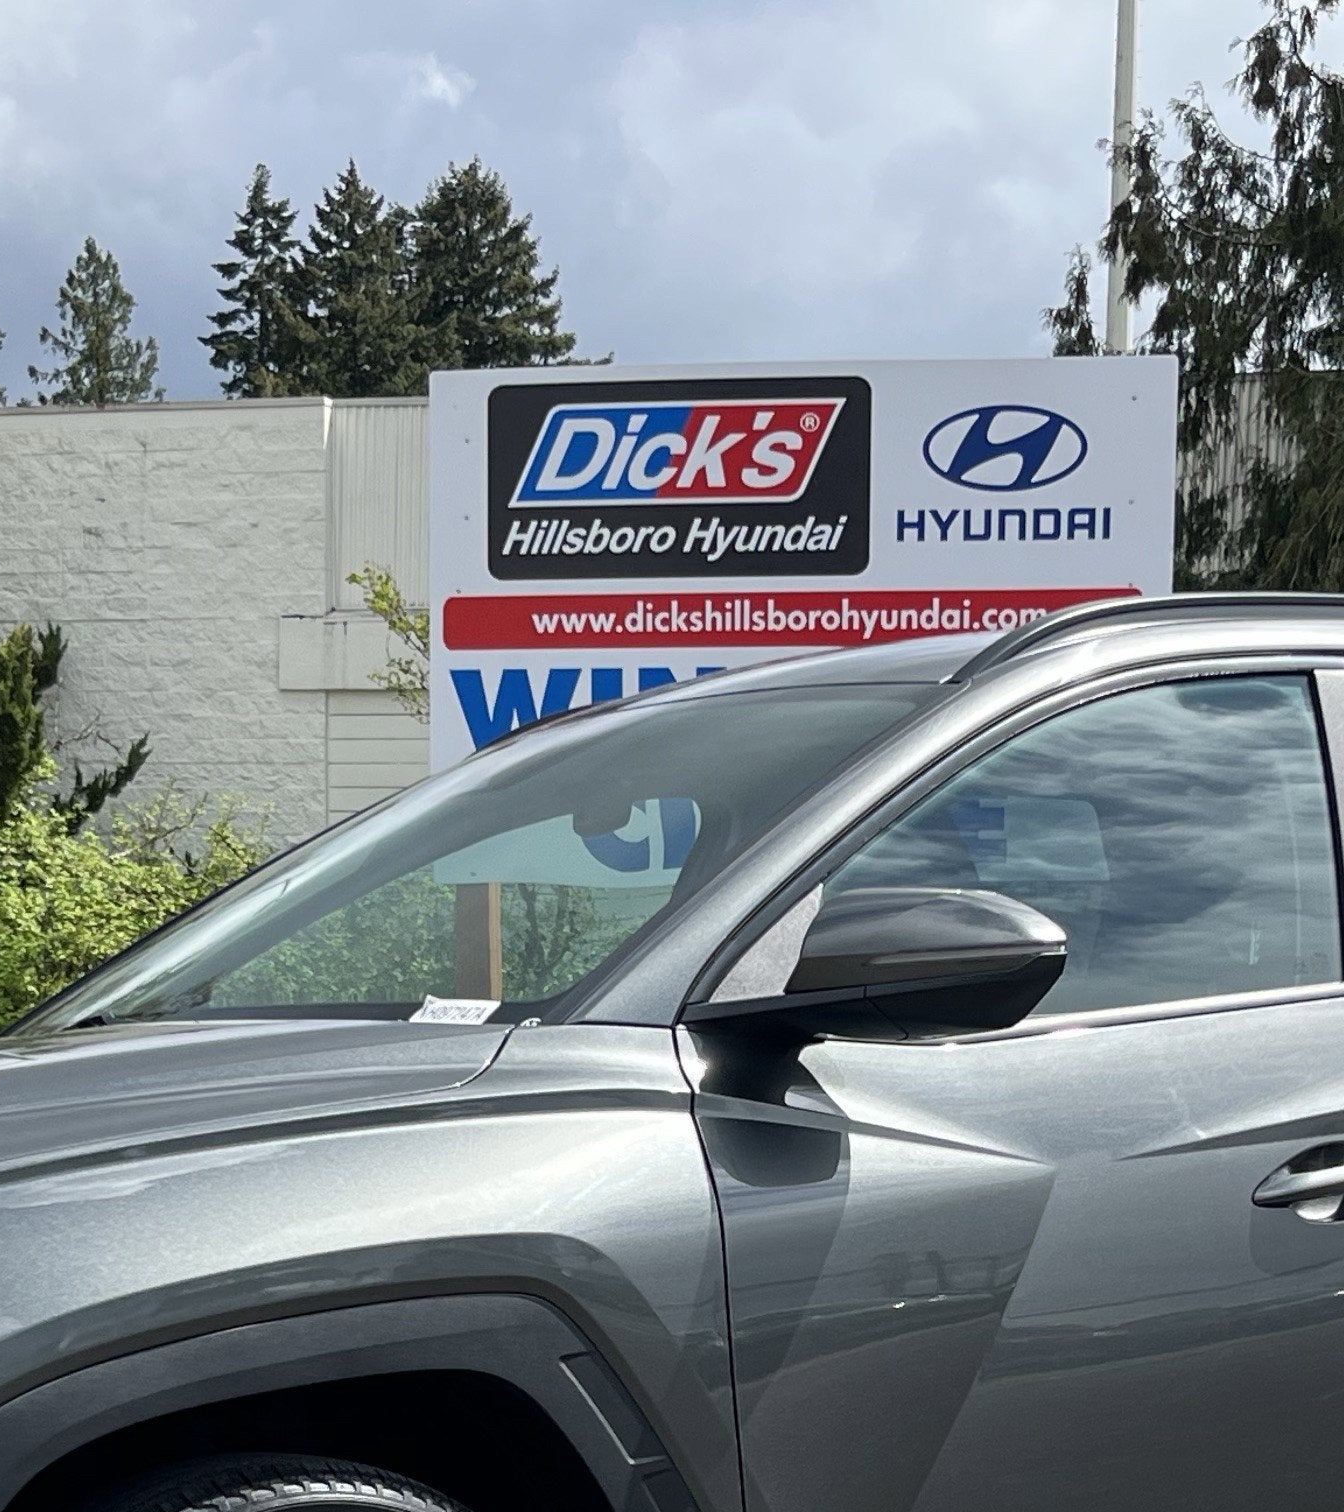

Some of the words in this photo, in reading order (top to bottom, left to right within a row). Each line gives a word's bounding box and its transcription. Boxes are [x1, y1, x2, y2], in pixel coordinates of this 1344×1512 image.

[535, 412, 803, 491] Dick's
[502, 518, 676, 555] Hillsboro
[683, 514, 848, 562] Hyundai
[896, 507, 1113, 543] HYUNDAI
[531, 597, 1047, 640] www.dickshillsborohyundai.com
